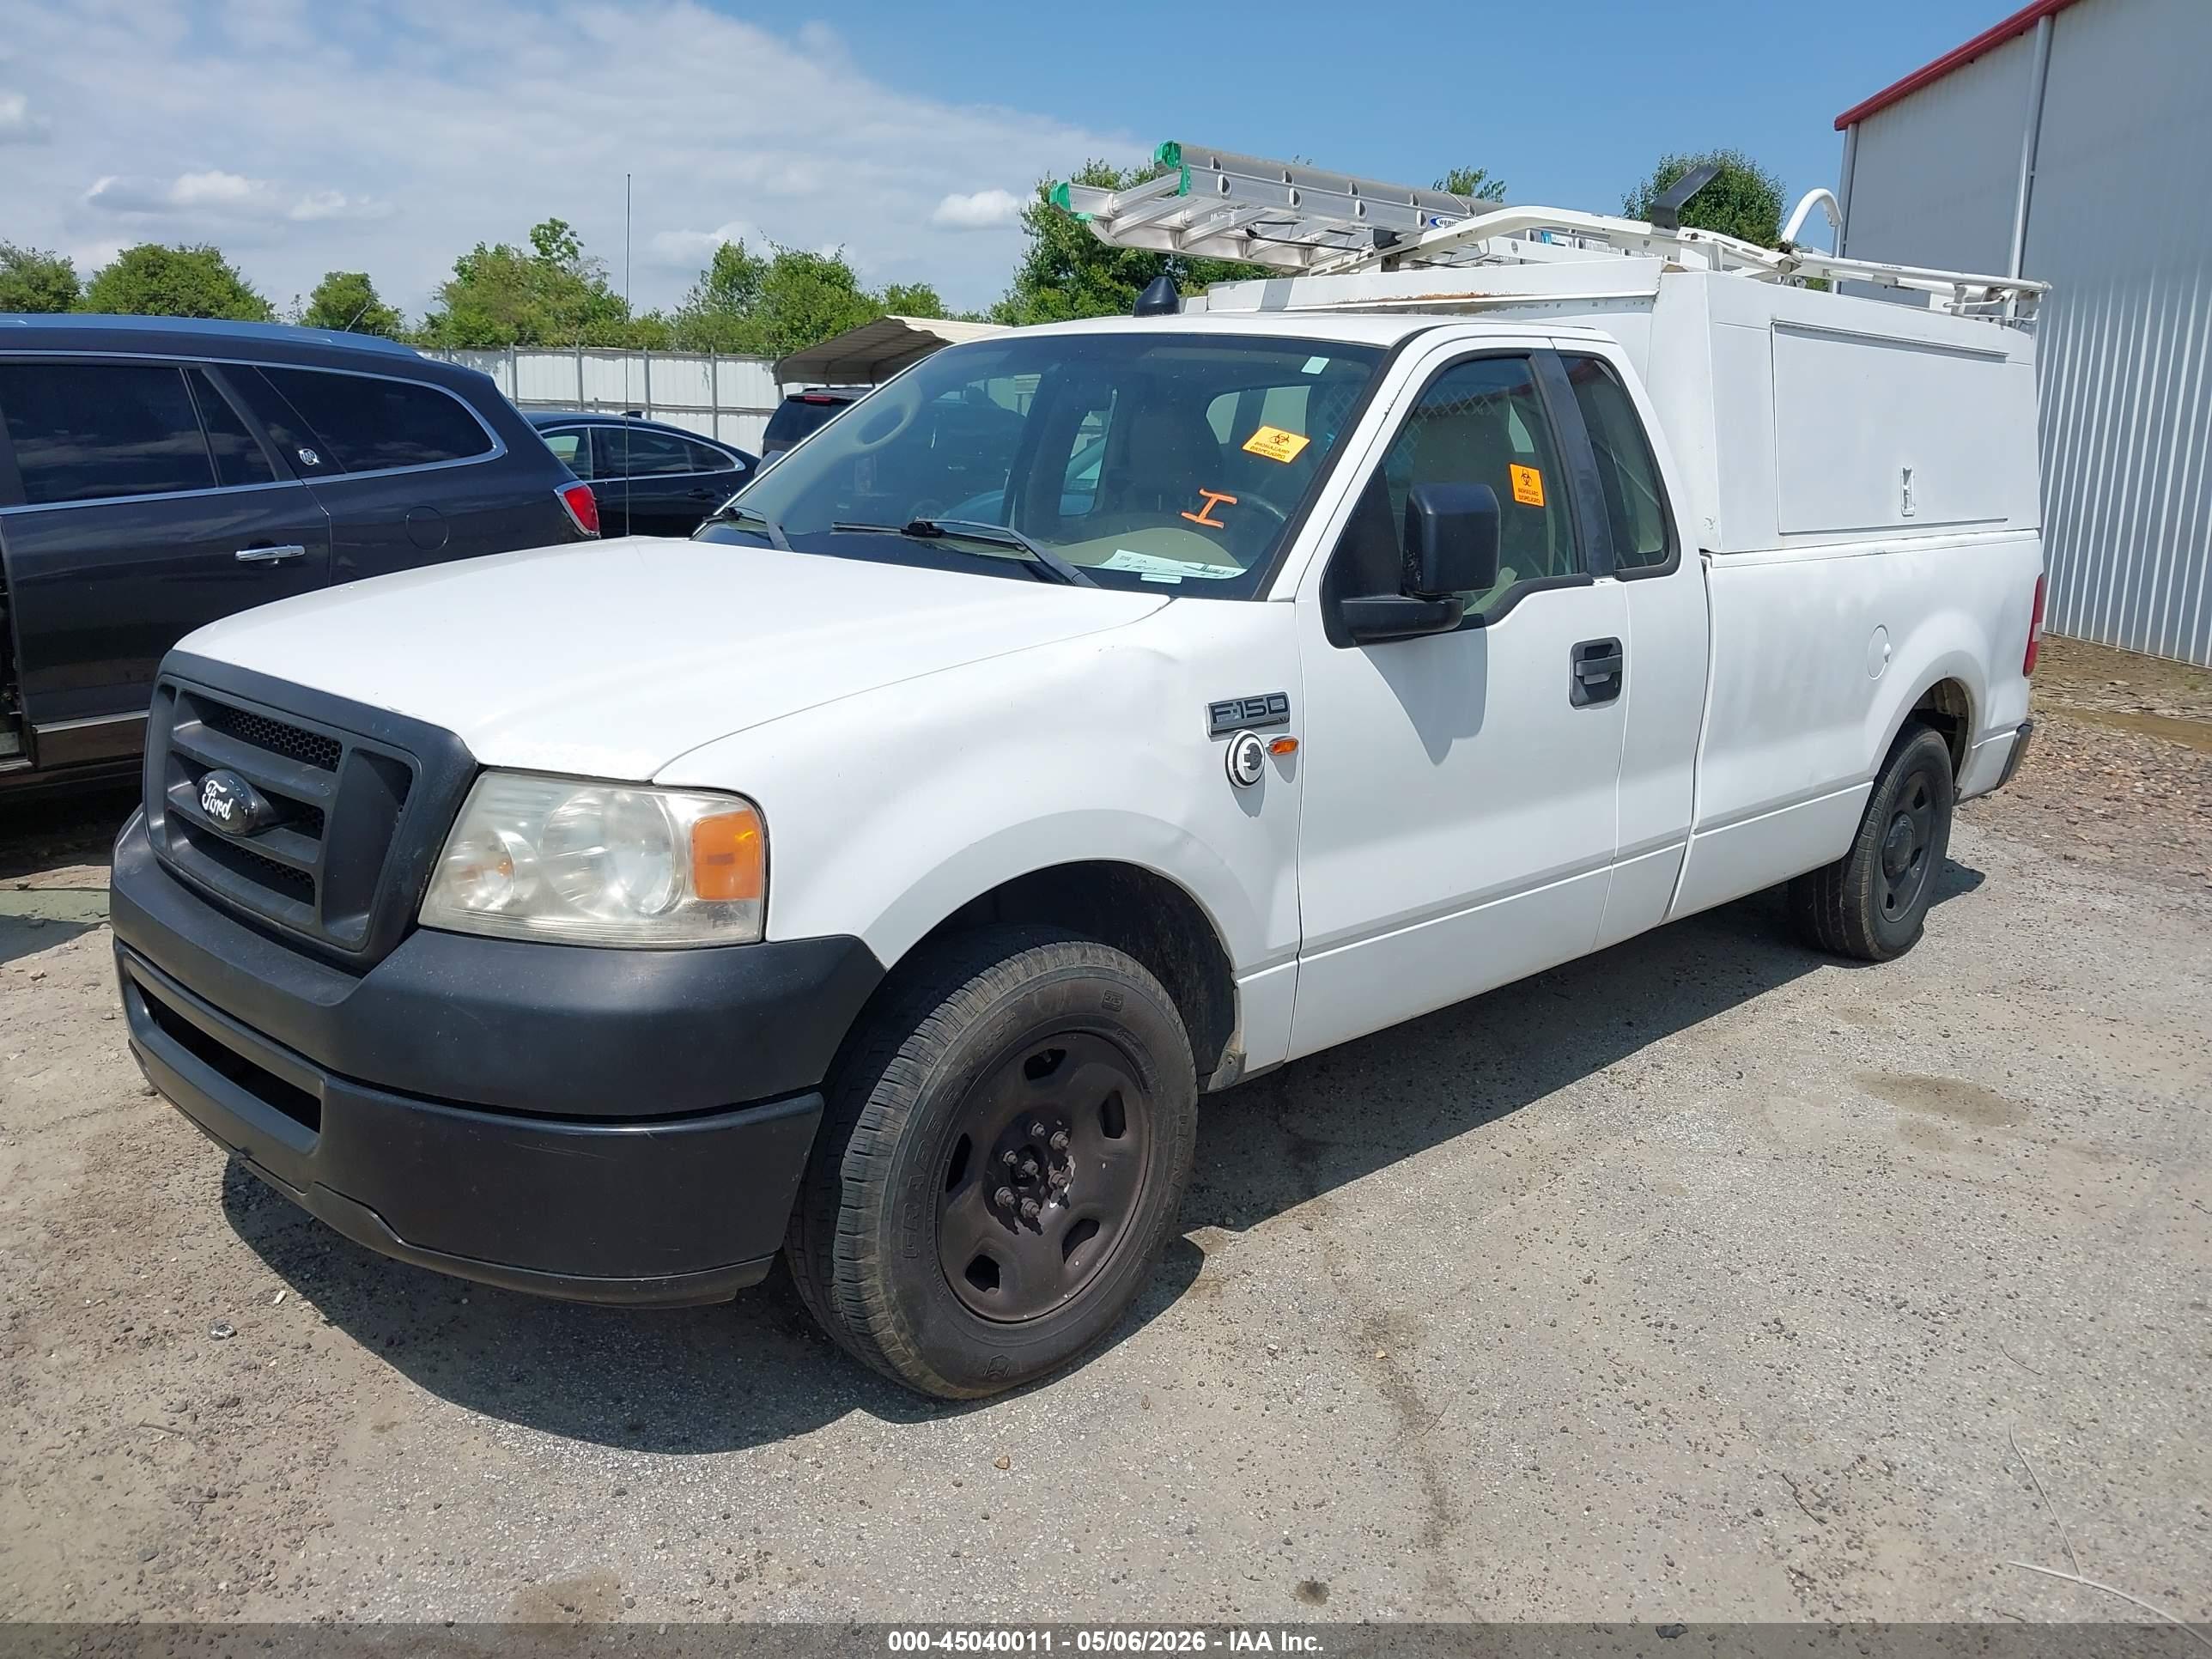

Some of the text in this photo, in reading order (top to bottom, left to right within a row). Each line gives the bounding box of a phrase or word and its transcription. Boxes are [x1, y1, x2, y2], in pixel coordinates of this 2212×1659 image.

[1254, 441, 1291, 455] BIOHAZARD
[1211, 695, 1289, 724] F-150
[202, 780, 234, 821] Ford
